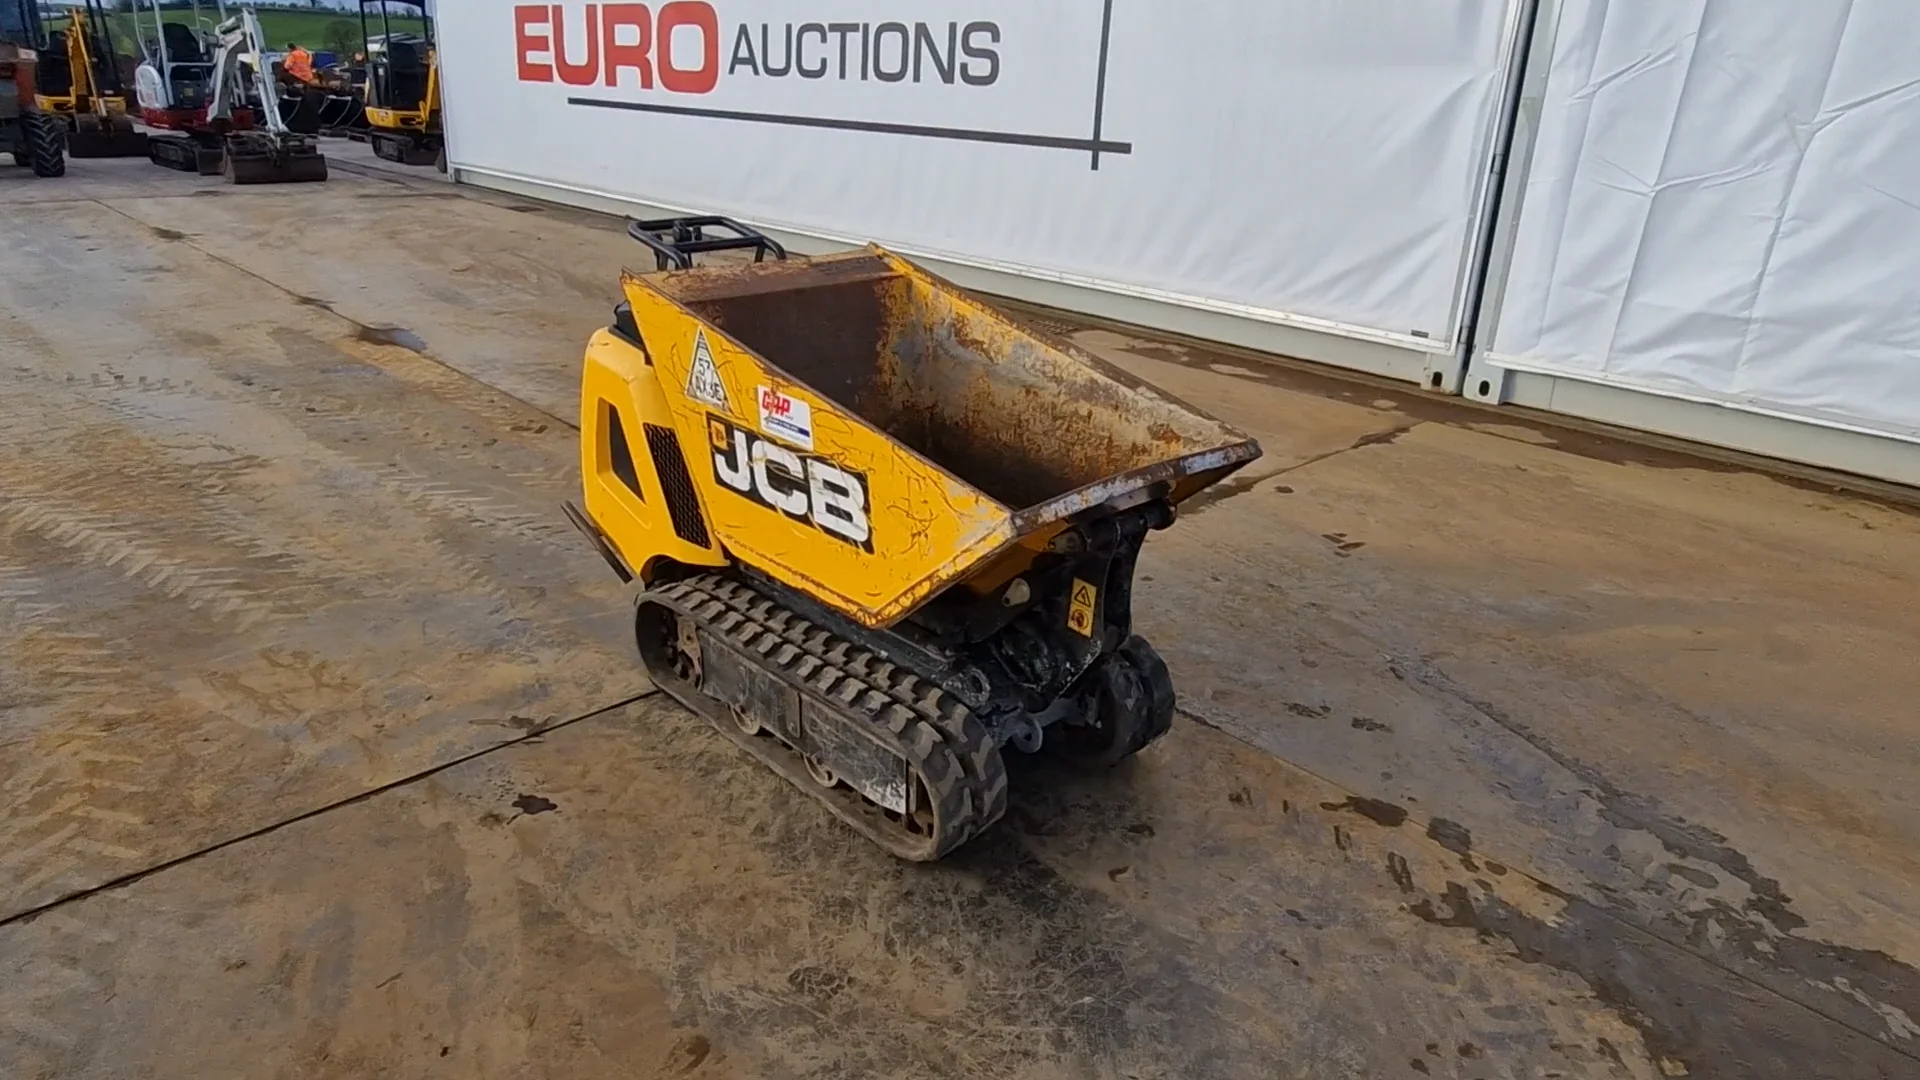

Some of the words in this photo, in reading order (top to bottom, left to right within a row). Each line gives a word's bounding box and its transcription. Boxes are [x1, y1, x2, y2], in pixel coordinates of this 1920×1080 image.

[514, 1, 718, 94] EURO
[728, 21, 1000, 86] AUCTIONS
[714, 429, 869, 542] JCB
